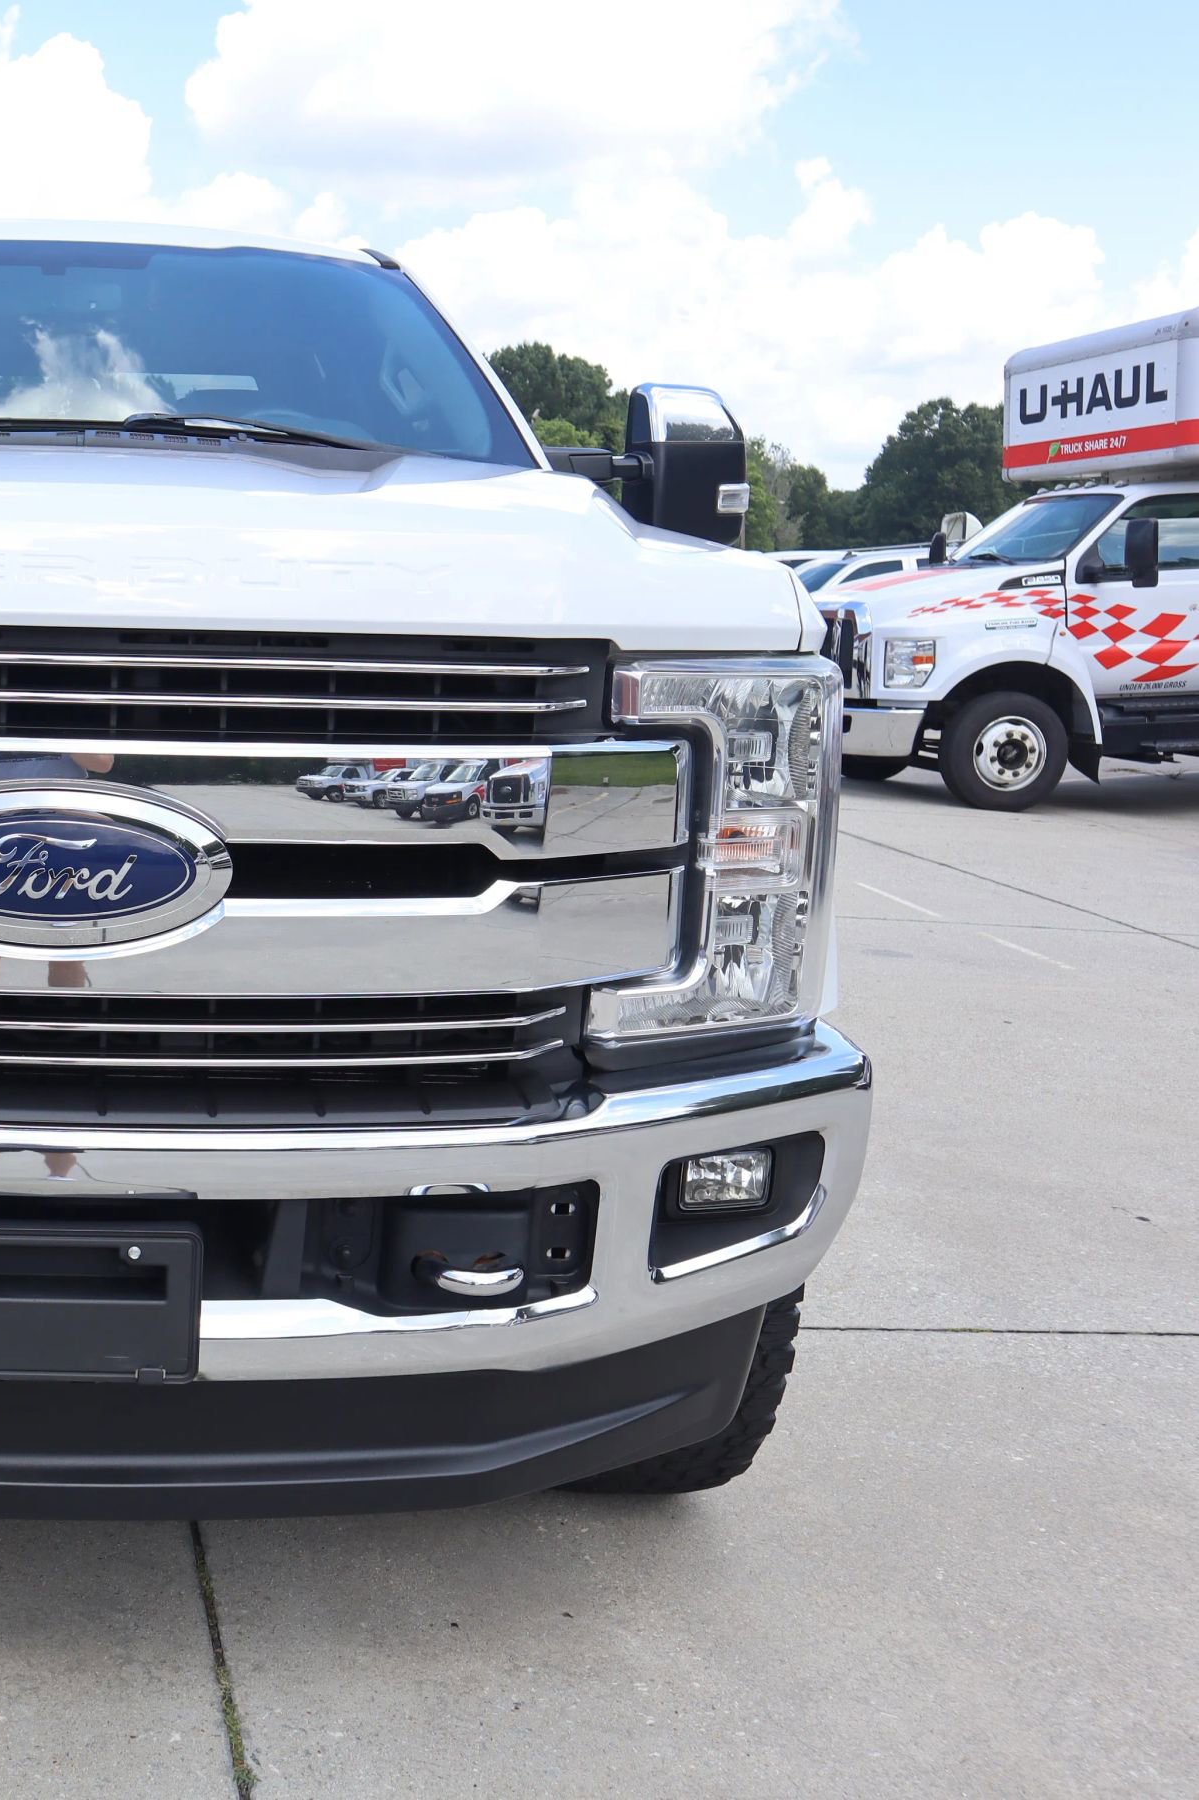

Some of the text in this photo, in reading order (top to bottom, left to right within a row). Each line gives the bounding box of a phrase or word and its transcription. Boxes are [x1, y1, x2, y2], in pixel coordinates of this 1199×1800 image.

[1019, 361, 1168, 425] U-HAUL
[1060, 435, 1126, 455] TRUCK SHARE 24/7
[1119, 682, 1143, 691] UNDER
[1163, 680, 1187, 689] GROSS
